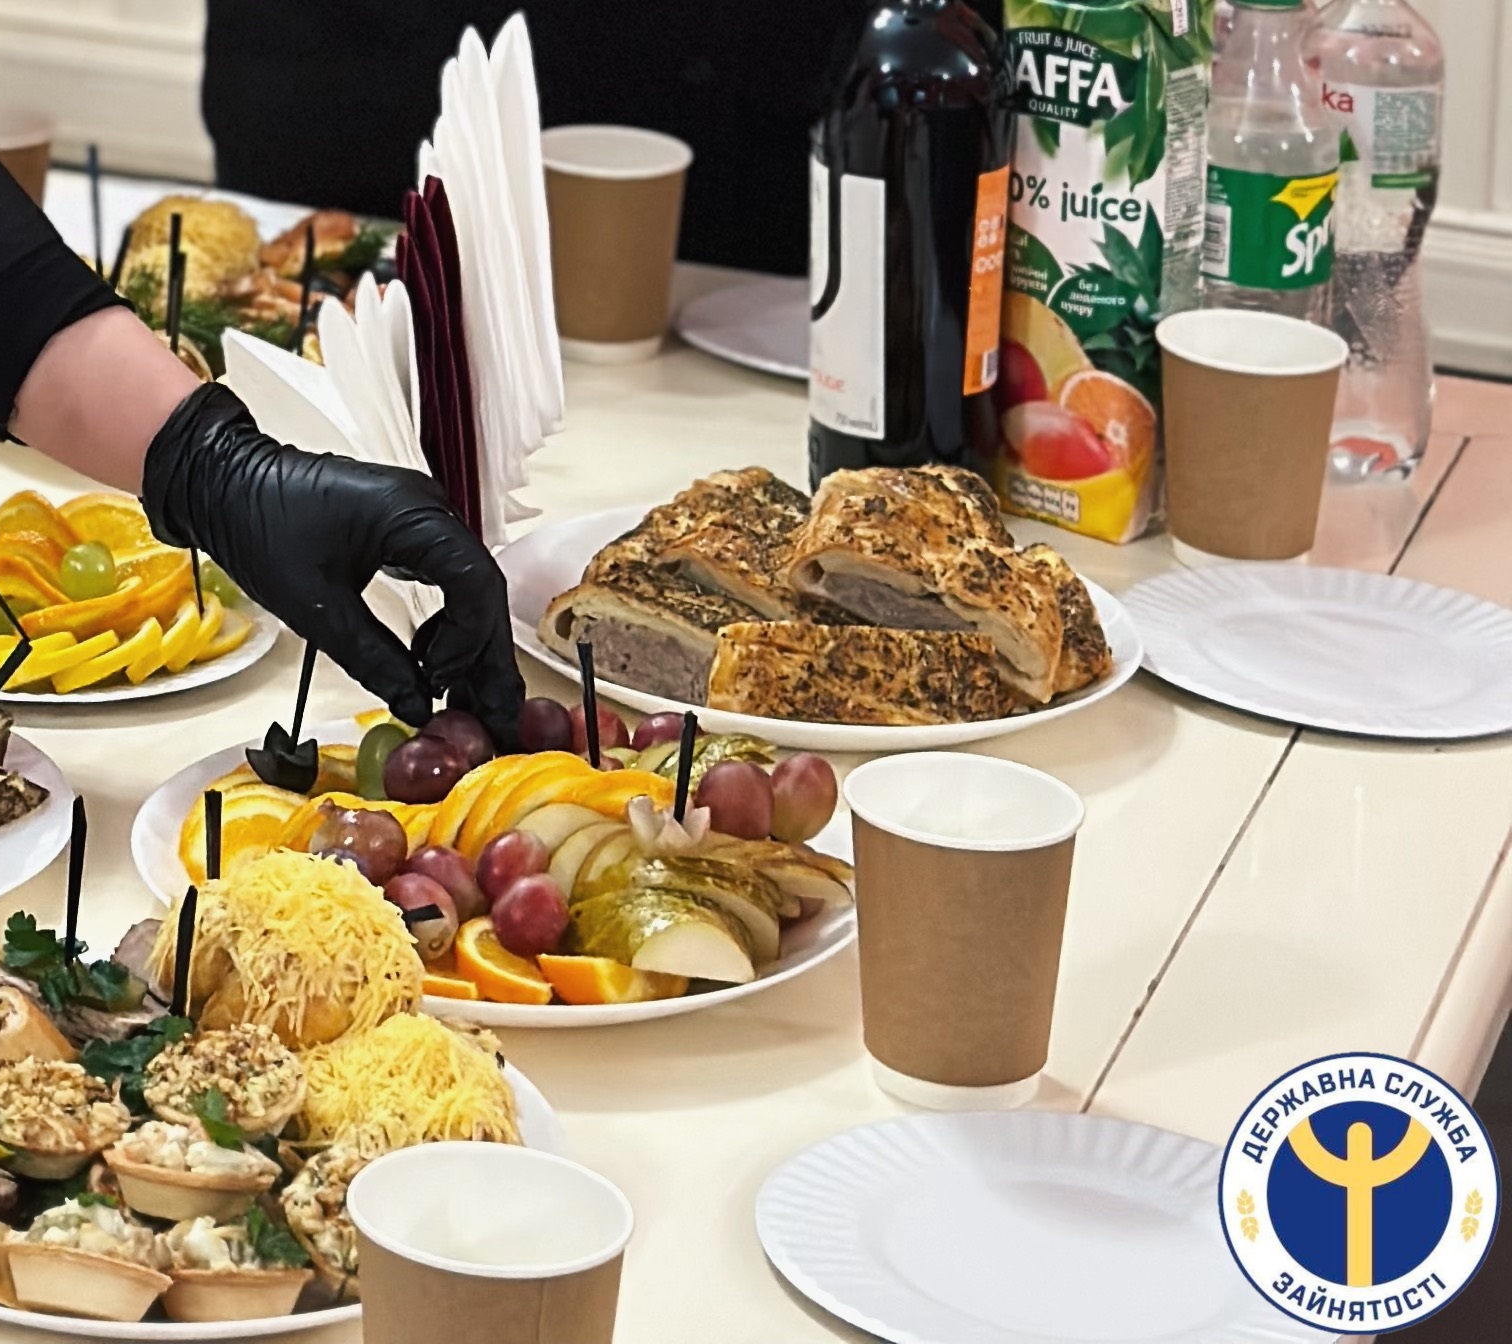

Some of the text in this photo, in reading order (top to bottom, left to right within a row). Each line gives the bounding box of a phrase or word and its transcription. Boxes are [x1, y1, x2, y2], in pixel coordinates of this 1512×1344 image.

[1018, 31, 1099, 60] FRUIT & JUICE
[1015, 49, 1128, 111] AFFA
[1028, 99, 1079, 119] QUALITY
[1010, 172, 1142, 223] 0% juice
